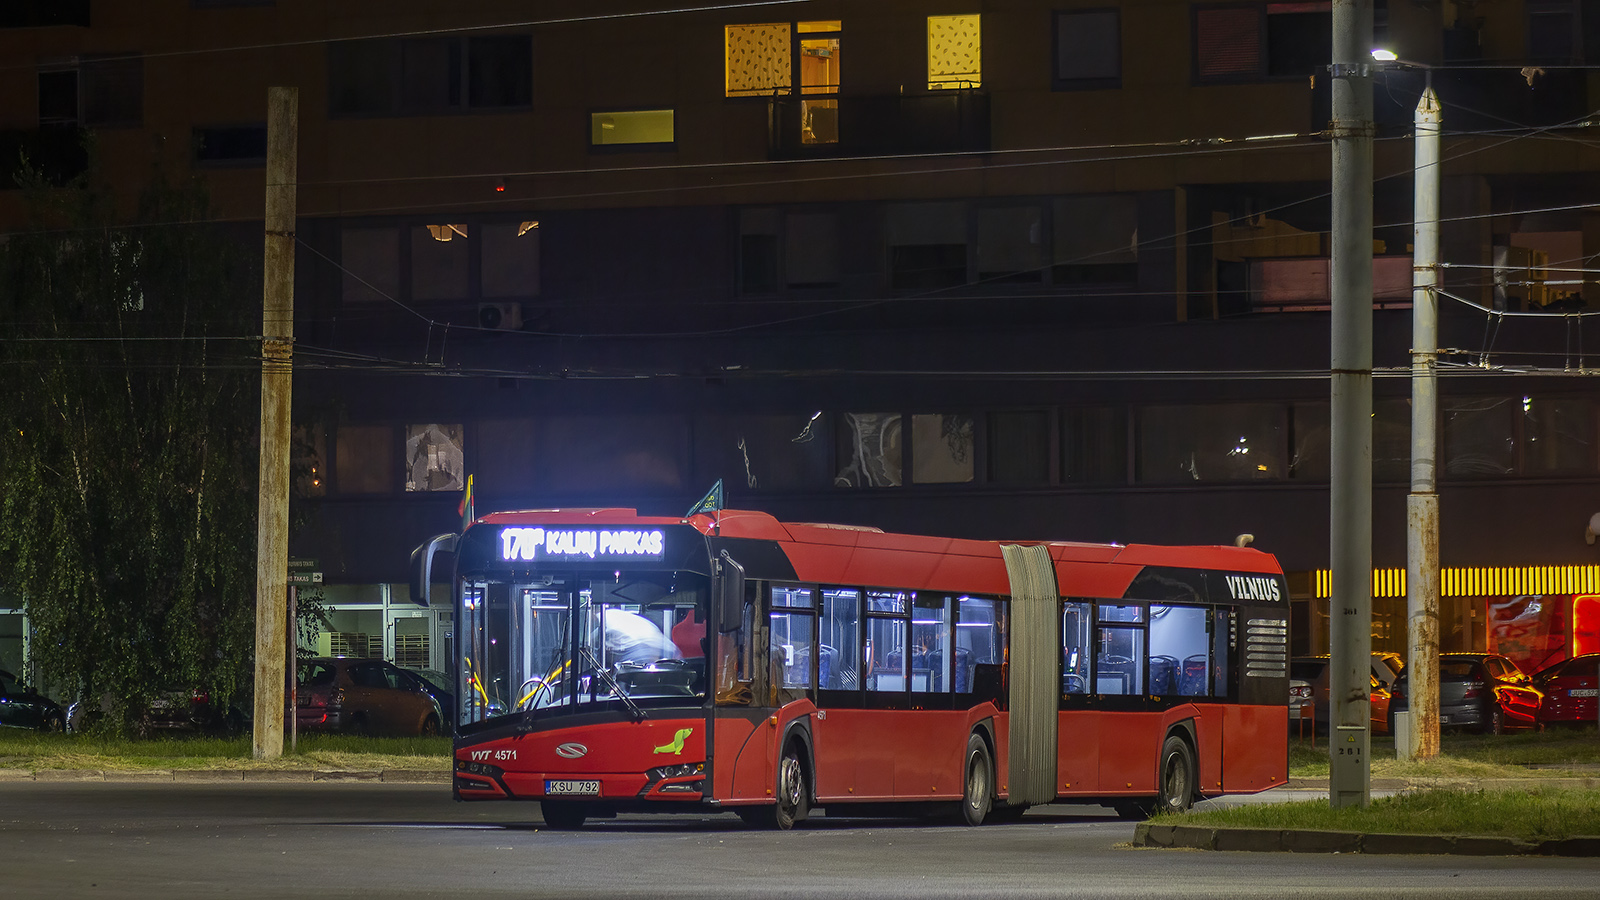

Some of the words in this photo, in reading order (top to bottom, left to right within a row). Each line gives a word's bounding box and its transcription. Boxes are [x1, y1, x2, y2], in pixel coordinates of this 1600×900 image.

[599, 530, 663, 555] PARKAS
[1225, 575, 1281, 602] VILNIUS
[471, 750, 492, 761] VVT
[494, 750, 517, 761] 4571
[551, 782, 573, 792] KSU
[579, 782, 598, 792] 792
